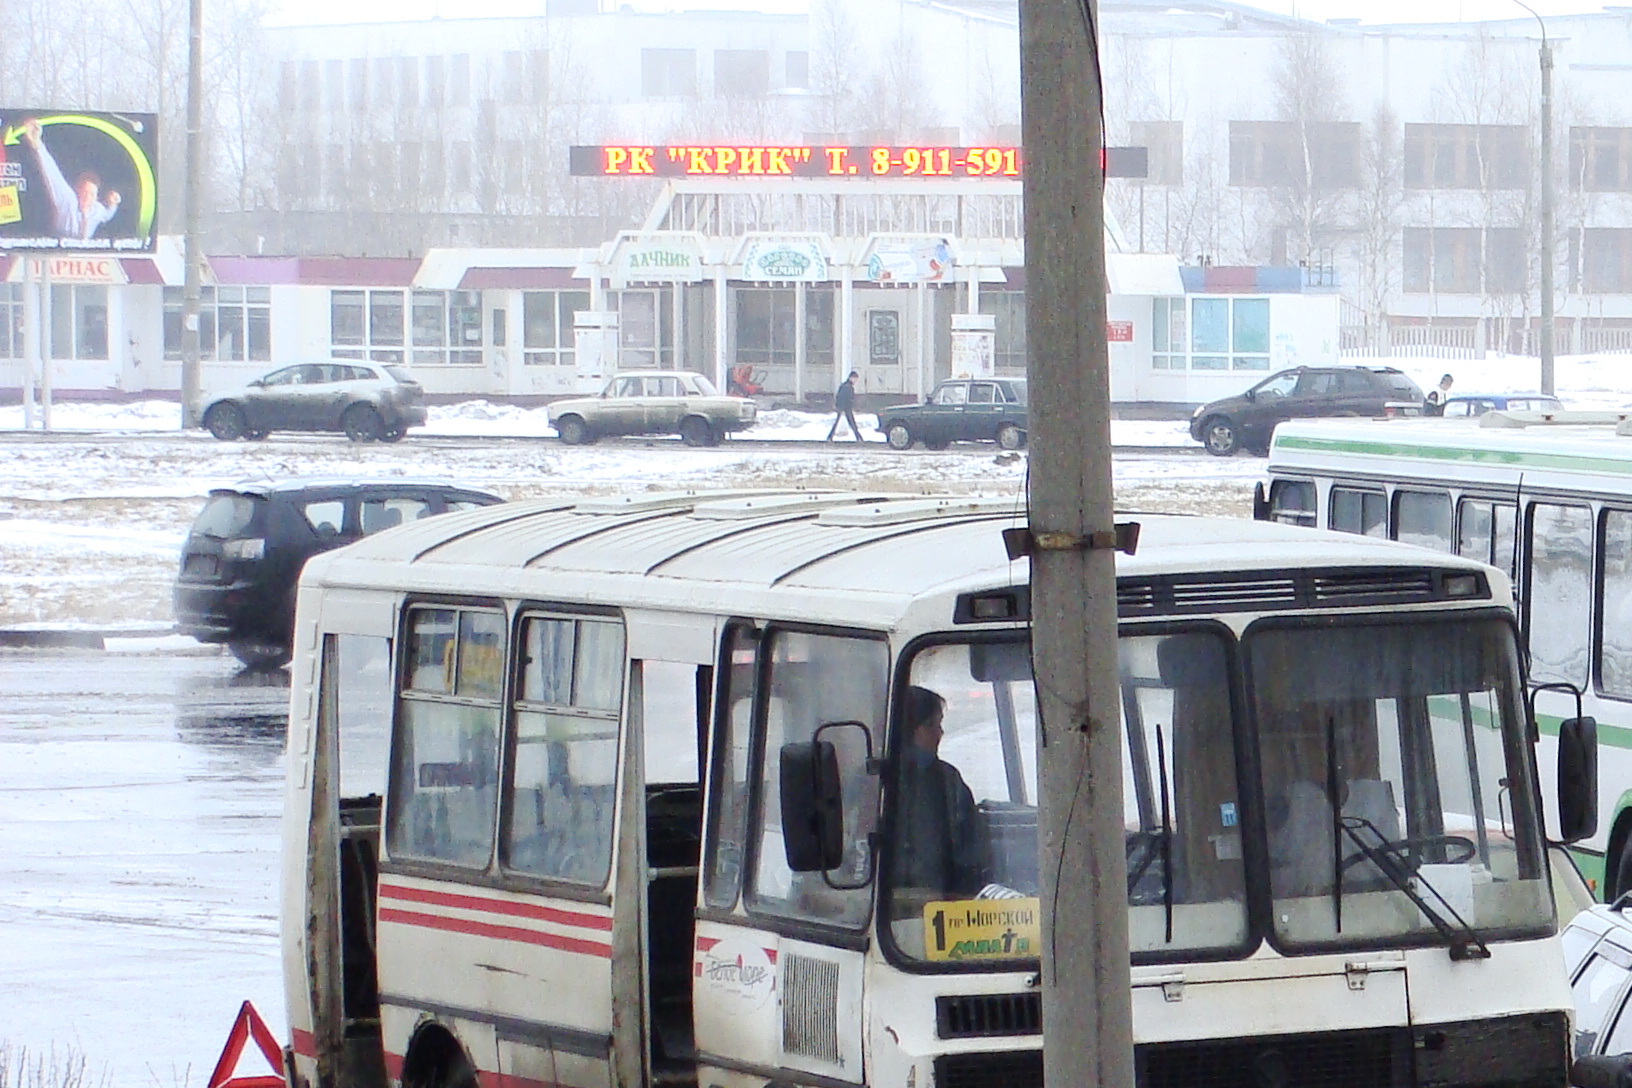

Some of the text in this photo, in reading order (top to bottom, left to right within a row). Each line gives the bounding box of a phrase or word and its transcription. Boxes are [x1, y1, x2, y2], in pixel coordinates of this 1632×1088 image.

[604, 147, 655, 174] РК
[668, 147, 812, 175] "КРИК"
[825, 147, 858, 175] Т.
[629, 250, 691, 268] ДАЧНИК
[932, 909, 946, 951] 1
